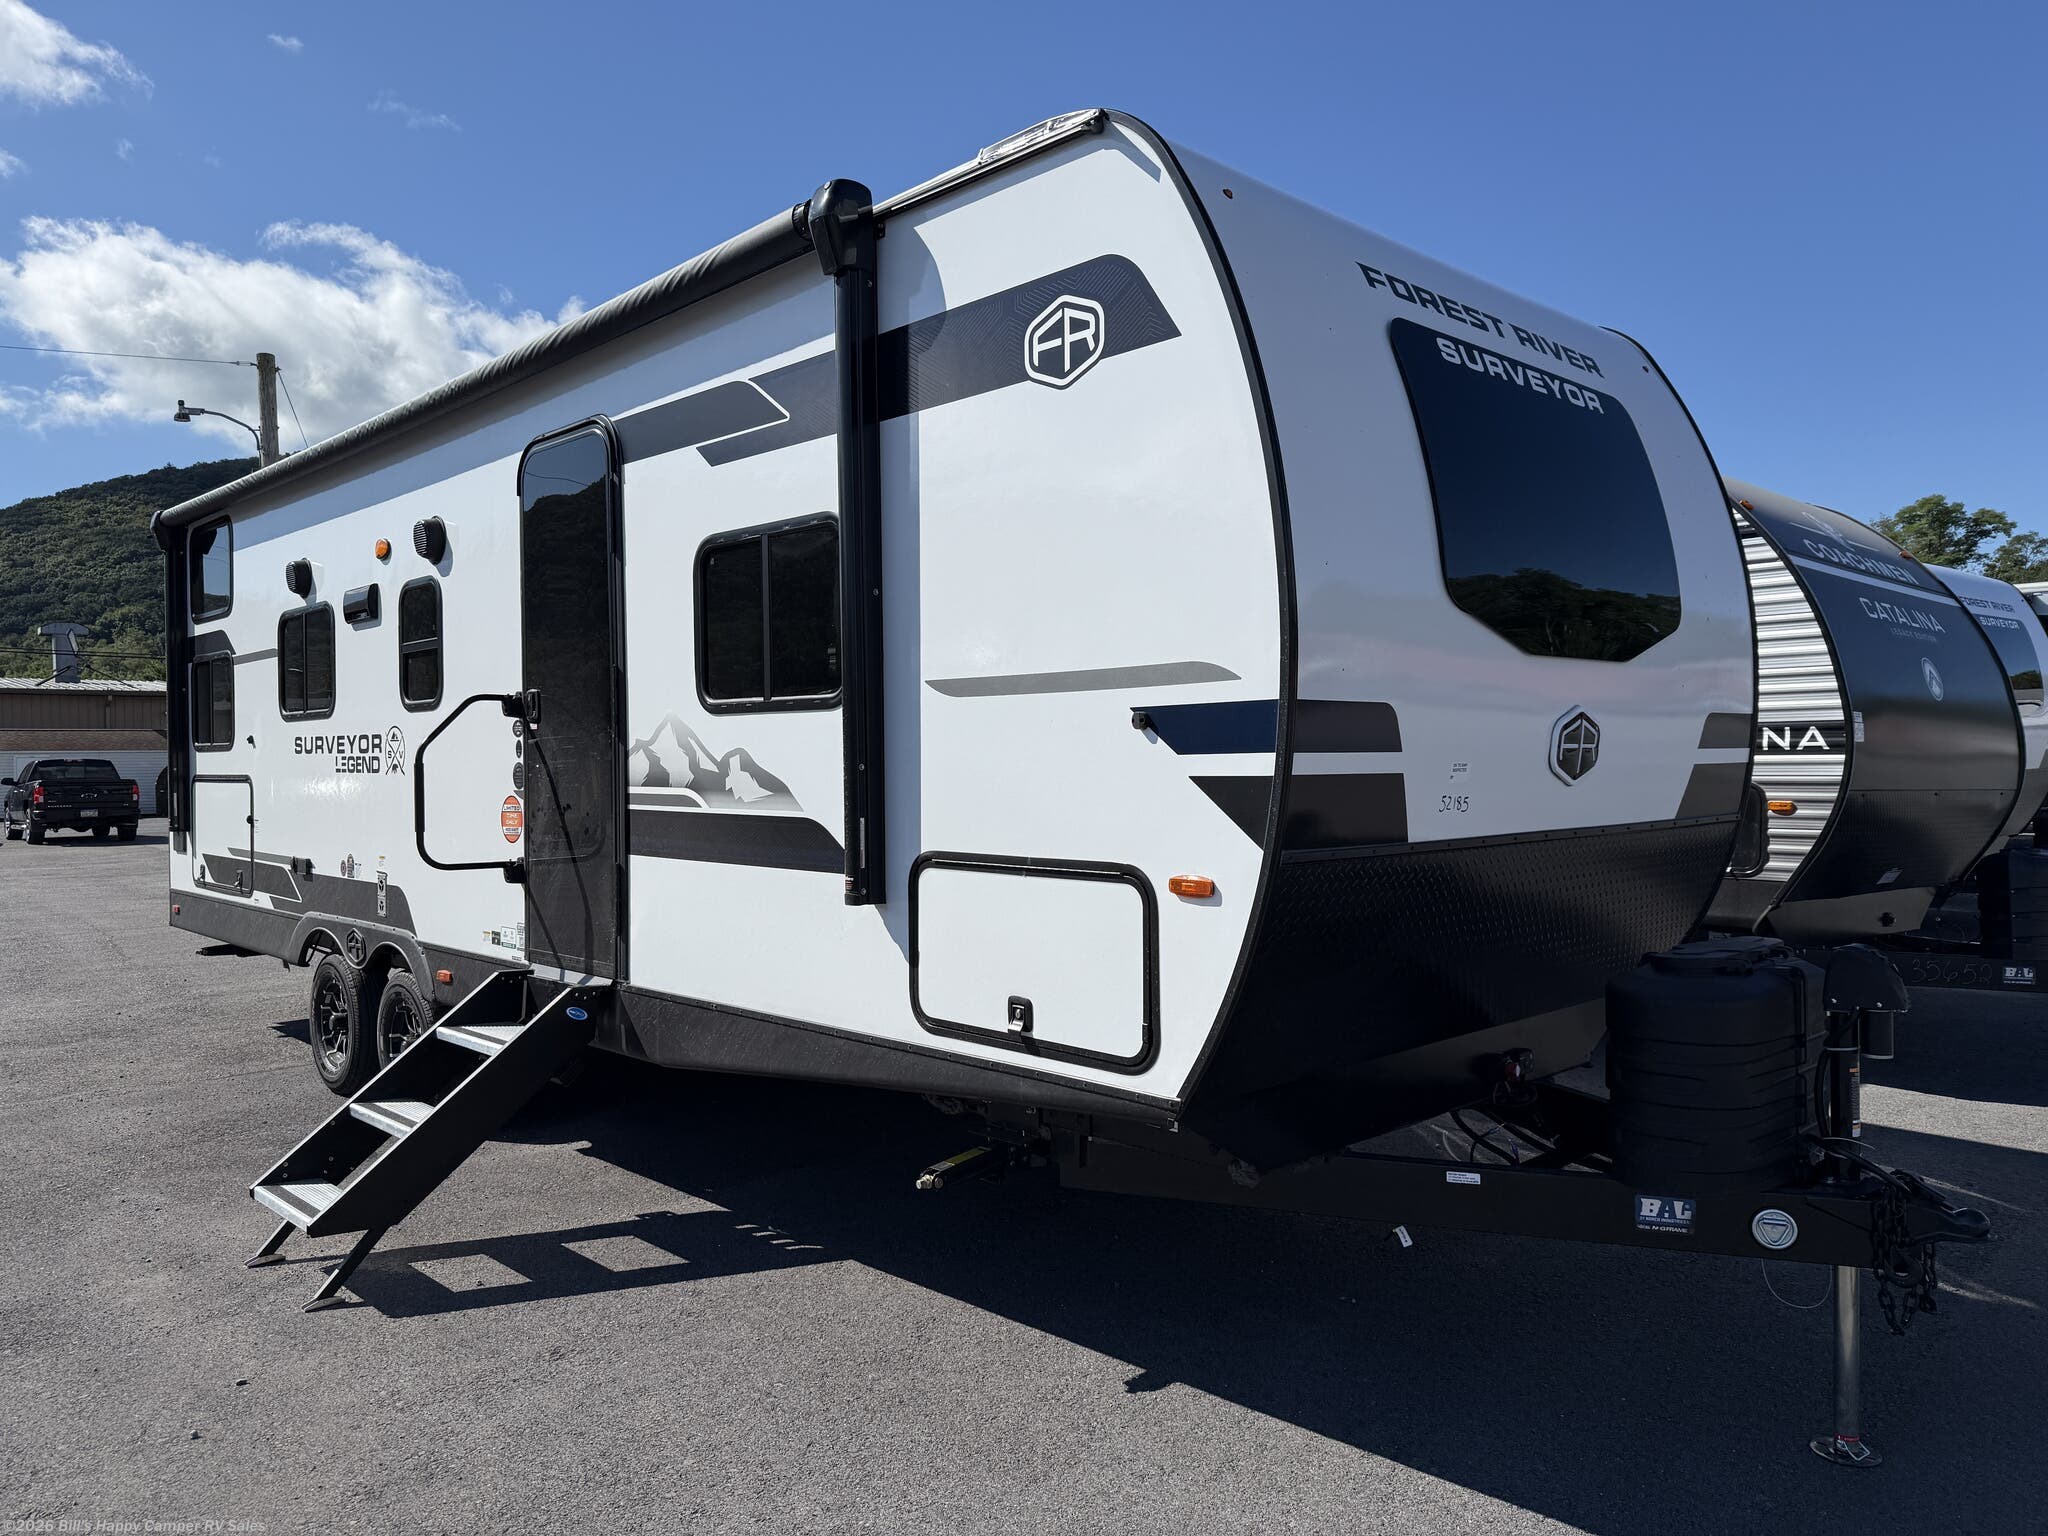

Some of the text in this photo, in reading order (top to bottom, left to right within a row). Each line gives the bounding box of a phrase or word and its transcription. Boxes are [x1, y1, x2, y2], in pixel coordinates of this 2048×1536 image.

[1355, 261, 1605, 379] FOREST RIVER
[1435, 336, 1605, 415] SURVEYOR
[1803, 538, 1920, 585] COACHMEN
[1859, 597, 1946, 633] CATALINA
[1979, 615, 2020, 630] SURVEYOR
[294, 733, 383, 755] SURVEYOR
[335, 755, 381, 774] LEGEND
[1438, 794, 1470, 813] 52185
[1640, 1197, 1692, 1220] BAL
